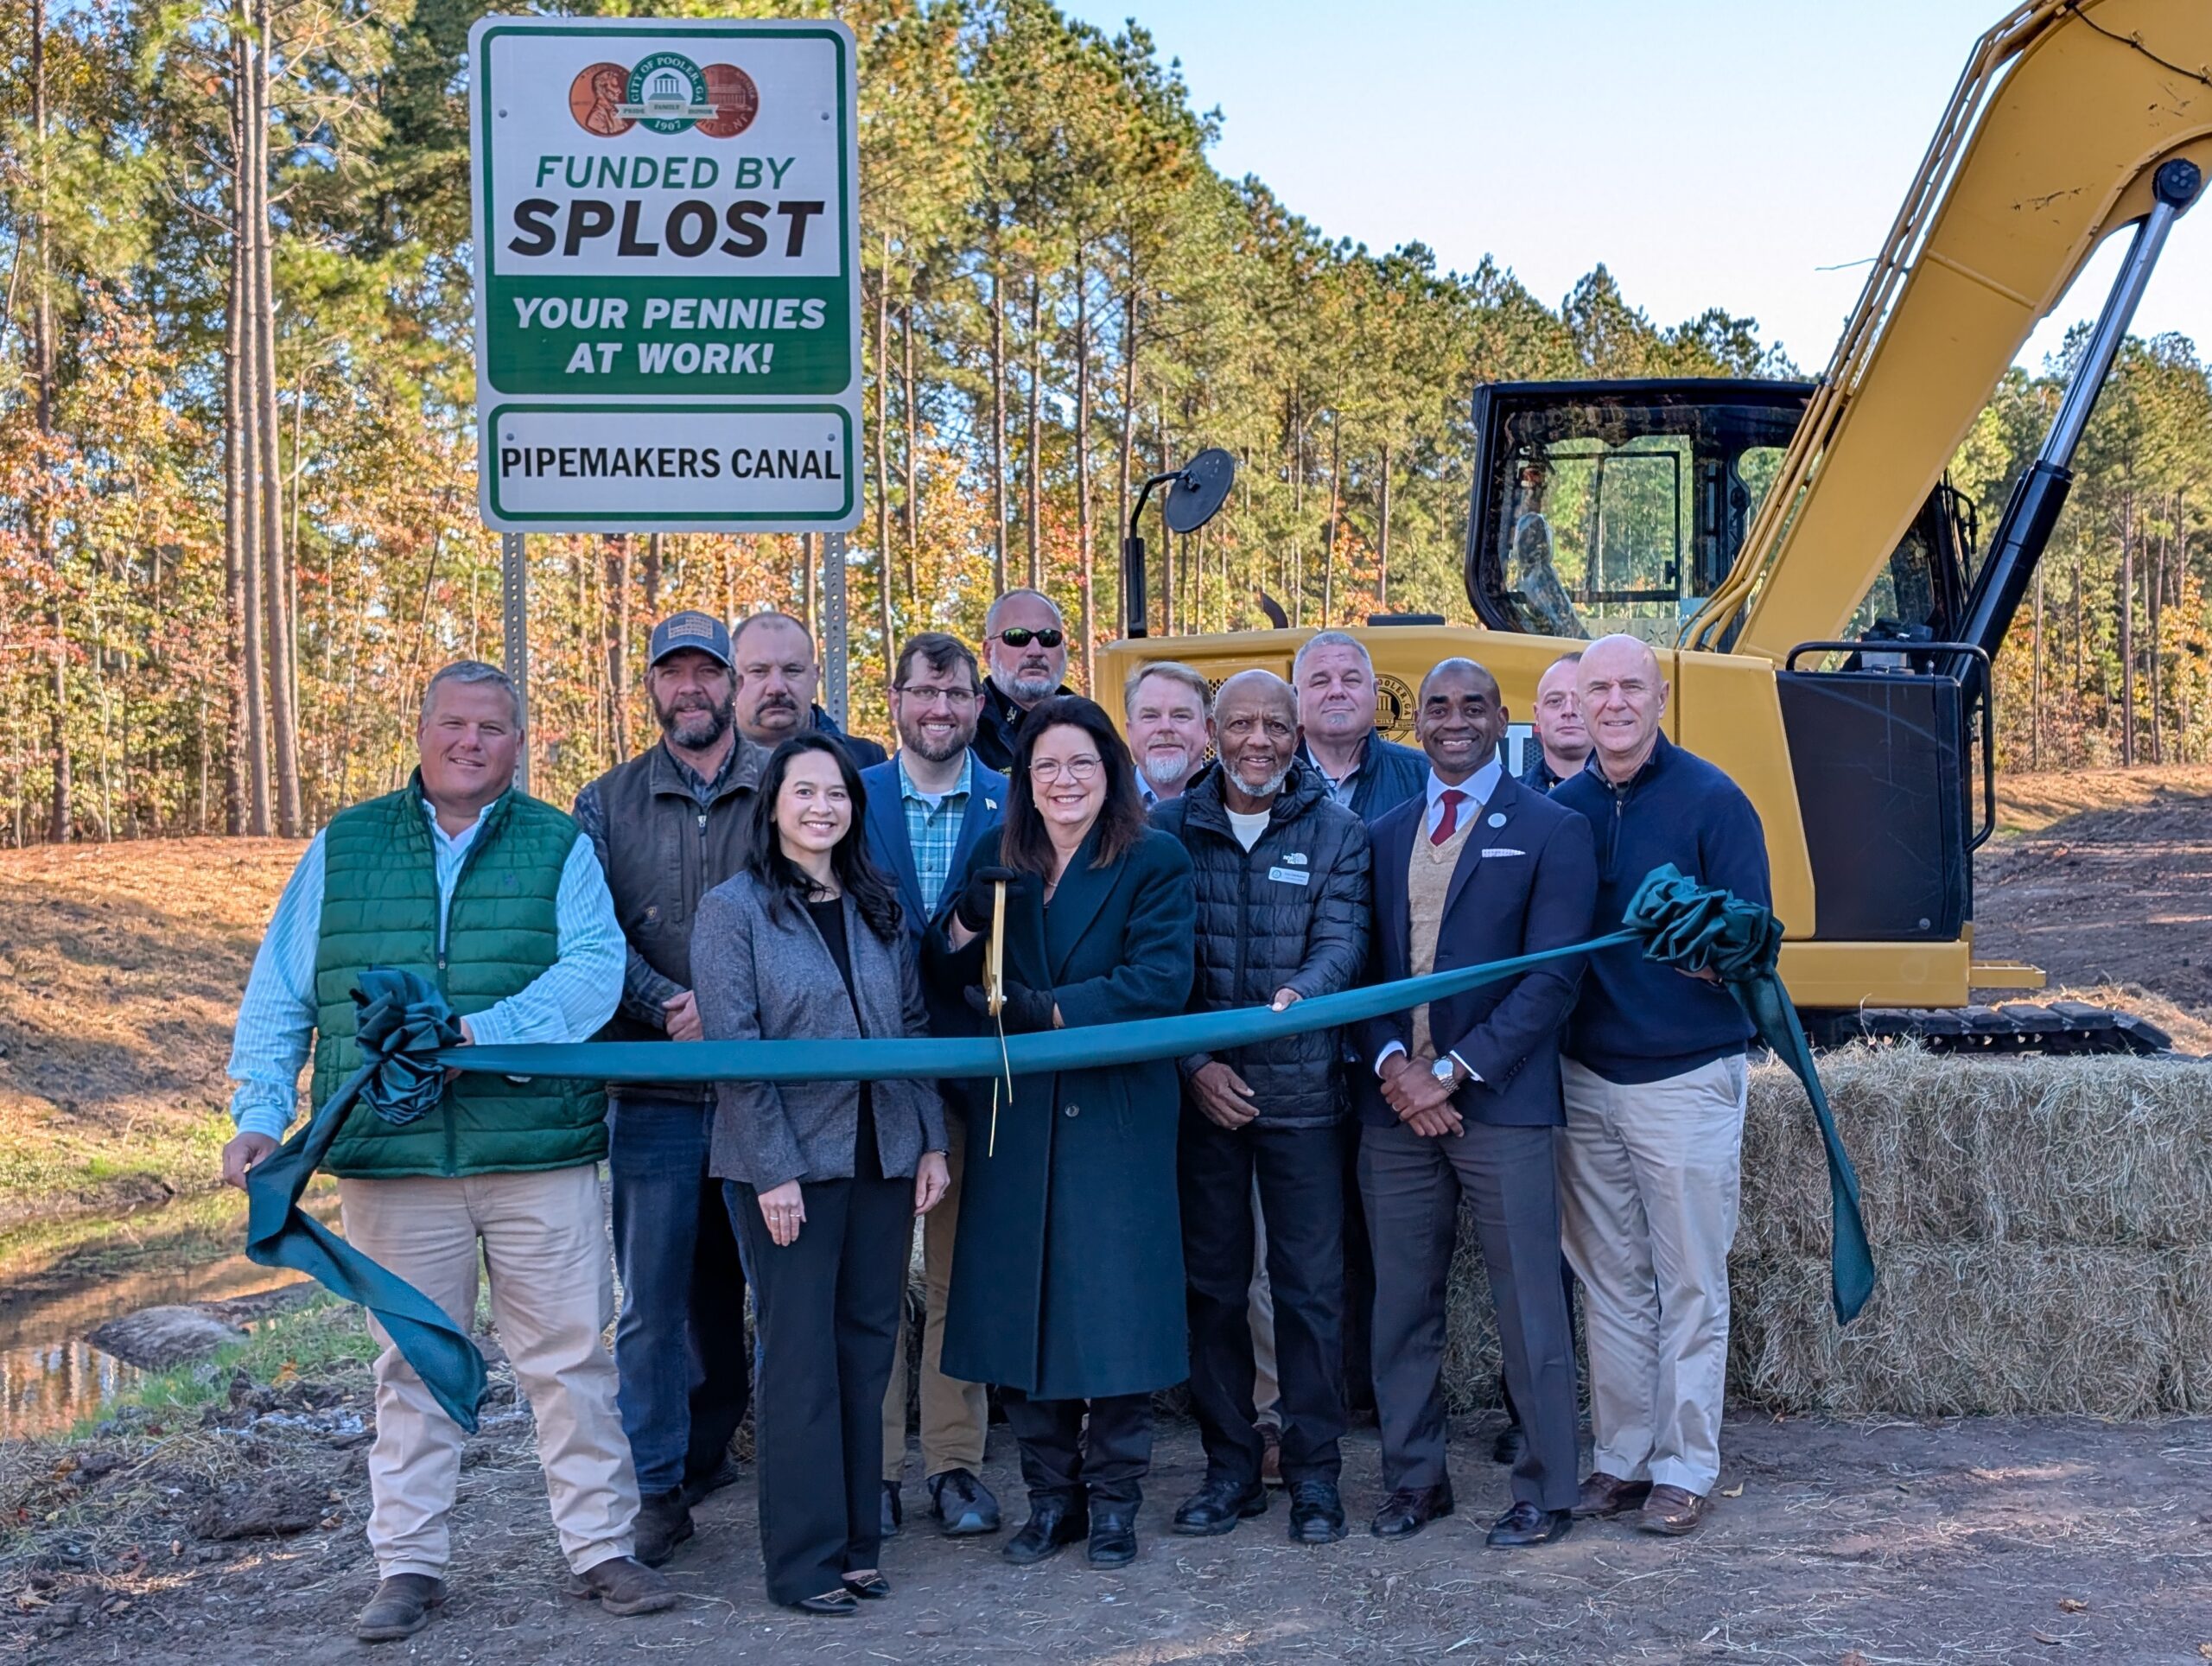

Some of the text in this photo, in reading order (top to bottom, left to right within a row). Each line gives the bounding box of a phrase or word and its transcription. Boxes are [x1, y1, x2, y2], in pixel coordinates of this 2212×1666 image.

[631, 73, 643, 102] CITY
[640, 60, 655, 73] OF
[695, 86, 704, 102] GA
[655, 119, 682, 131] 1907
[535, 156, 796, 190] FUNDED BY
[507, 198, 825, 258] SPLOST
[512, 296, 827, 329] YOUR PENNIES
[564, 342, 774, 374] AT WORK!
[501, 447, 842, 480] PIPEMAKERS CANAL
